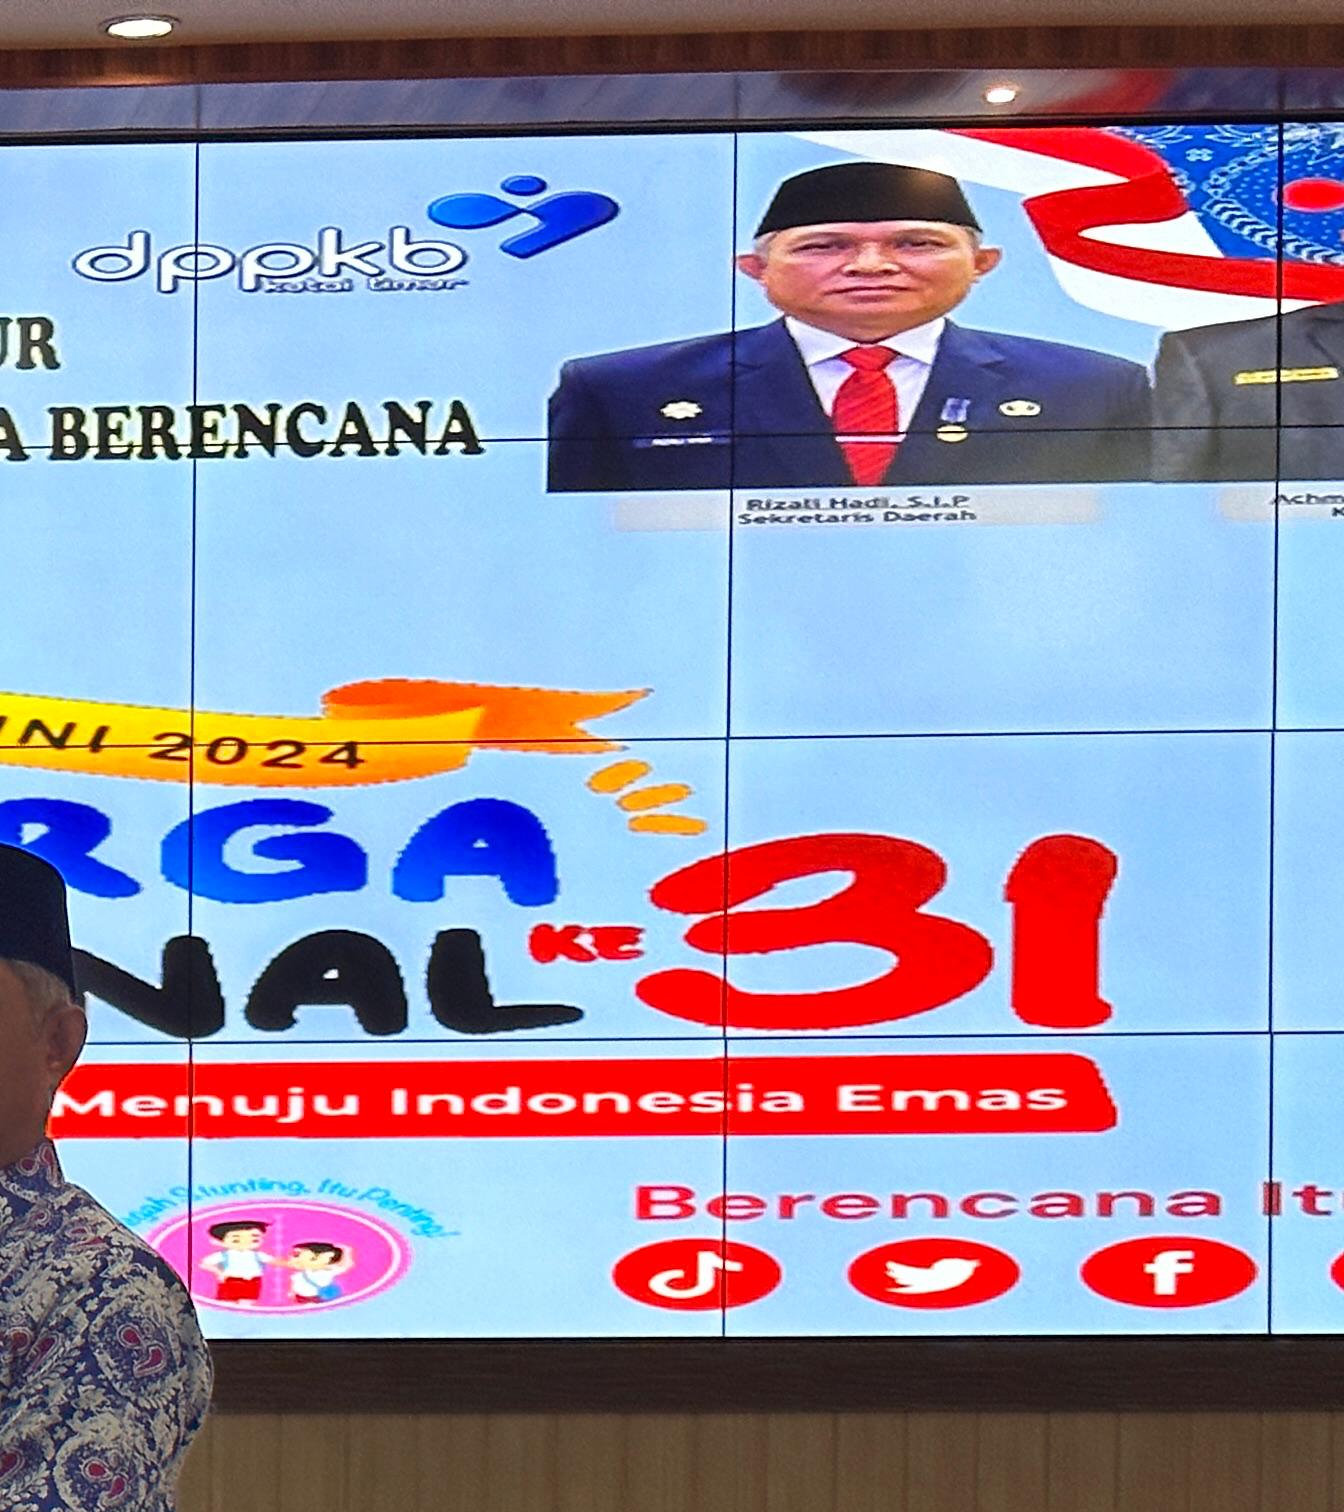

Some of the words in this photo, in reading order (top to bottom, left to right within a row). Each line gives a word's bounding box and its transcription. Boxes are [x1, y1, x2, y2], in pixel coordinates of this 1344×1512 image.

[72, 225, 468, 294] dppkb
[47, 399, 485, 462] BERENCANA
[738, 512, 874, 525] Sekretaris
[883, 510, 977, 523] Daerah
[148, 732, 367, 770] 2024
[528, 923, 646, 963] KE
[635, 832, 1119, 1031] 31
[51, 1087, 358, 1123] Menuju
[391, 1083, 805, 1116] Indonesia
[836, 1083, 1067, 1113] Emas
[635, 1184, 1222, 1222] Berencana
[1262, 1181, 1344, 1217] It
